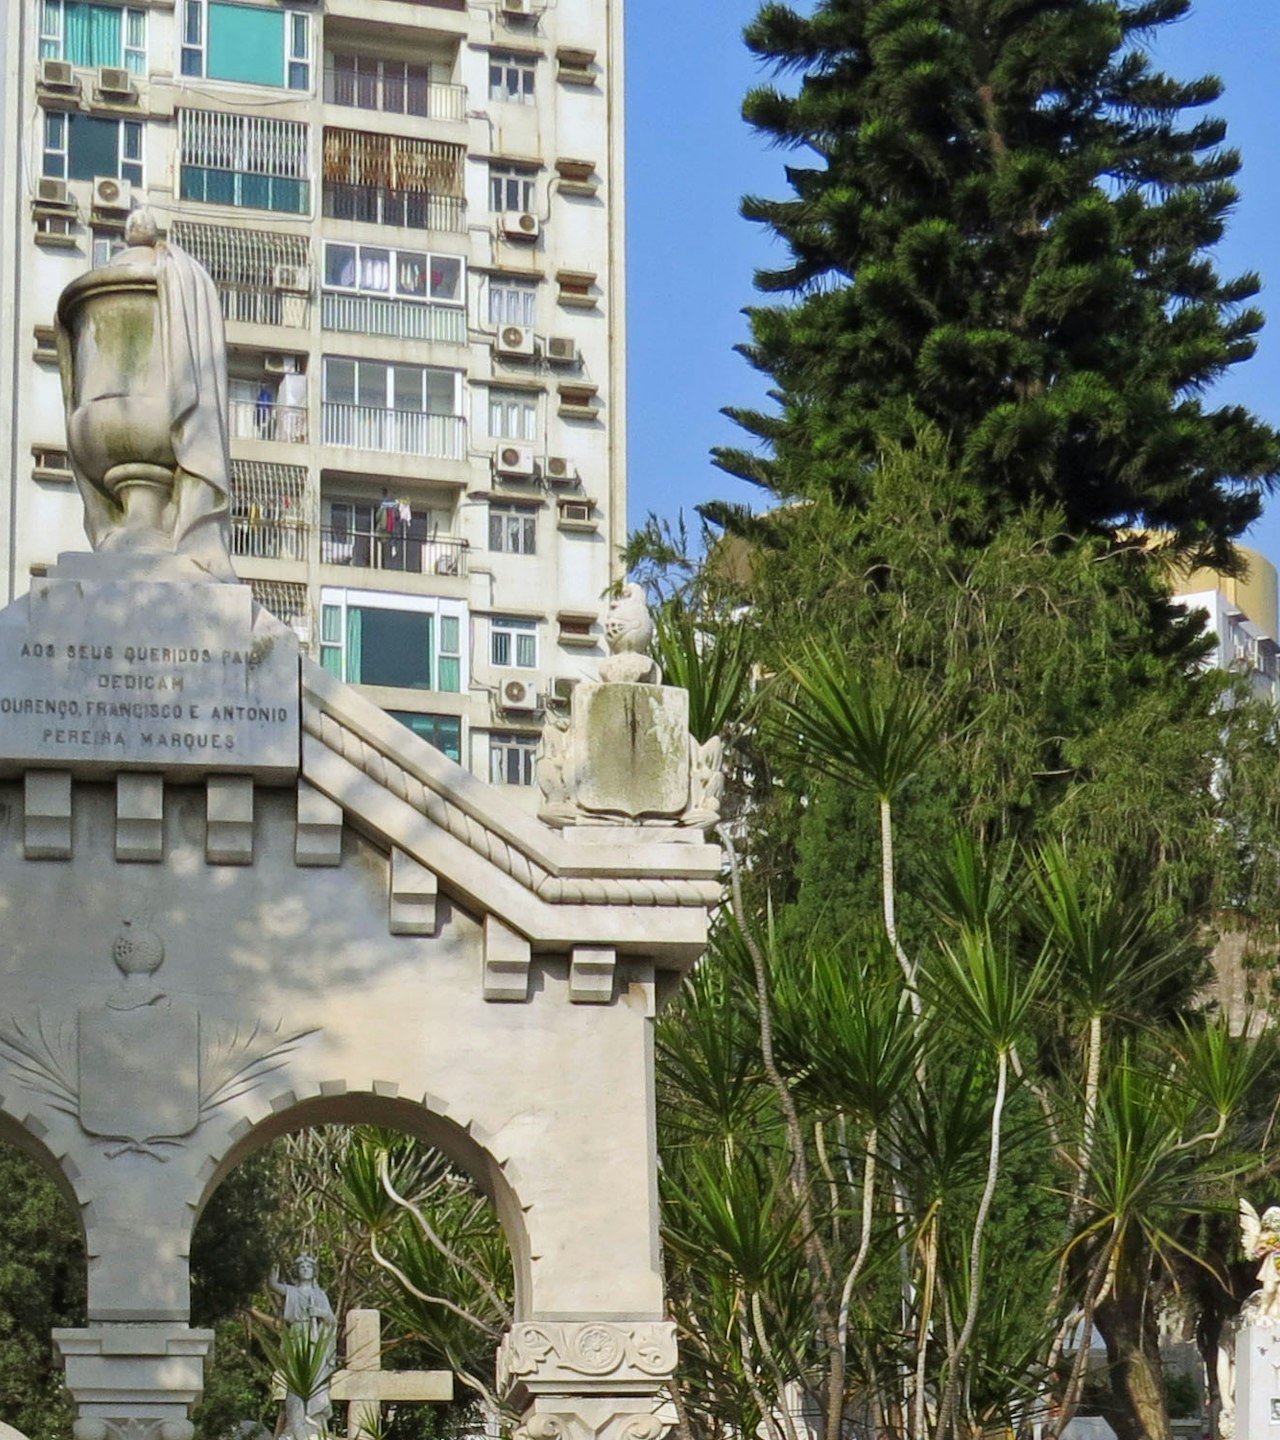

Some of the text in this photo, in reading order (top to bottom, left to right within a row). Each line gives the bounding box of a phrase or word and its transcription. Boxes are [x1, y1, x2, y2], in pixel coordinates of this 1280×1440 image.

[21, 644, 55, 658] AOS
[67, 645, 113, 660] SEUS
[124, 647, 212, 664] QUERIDOS
[98, 674, 184, 691] DEDICAM
[86, 703, 182, 720] FRANCISCO
[190, 705, 199, 719] E
[211, 707, 288, 722] ANTONIO
[43, 731, 235, 751] PEREIRA MARQUES
